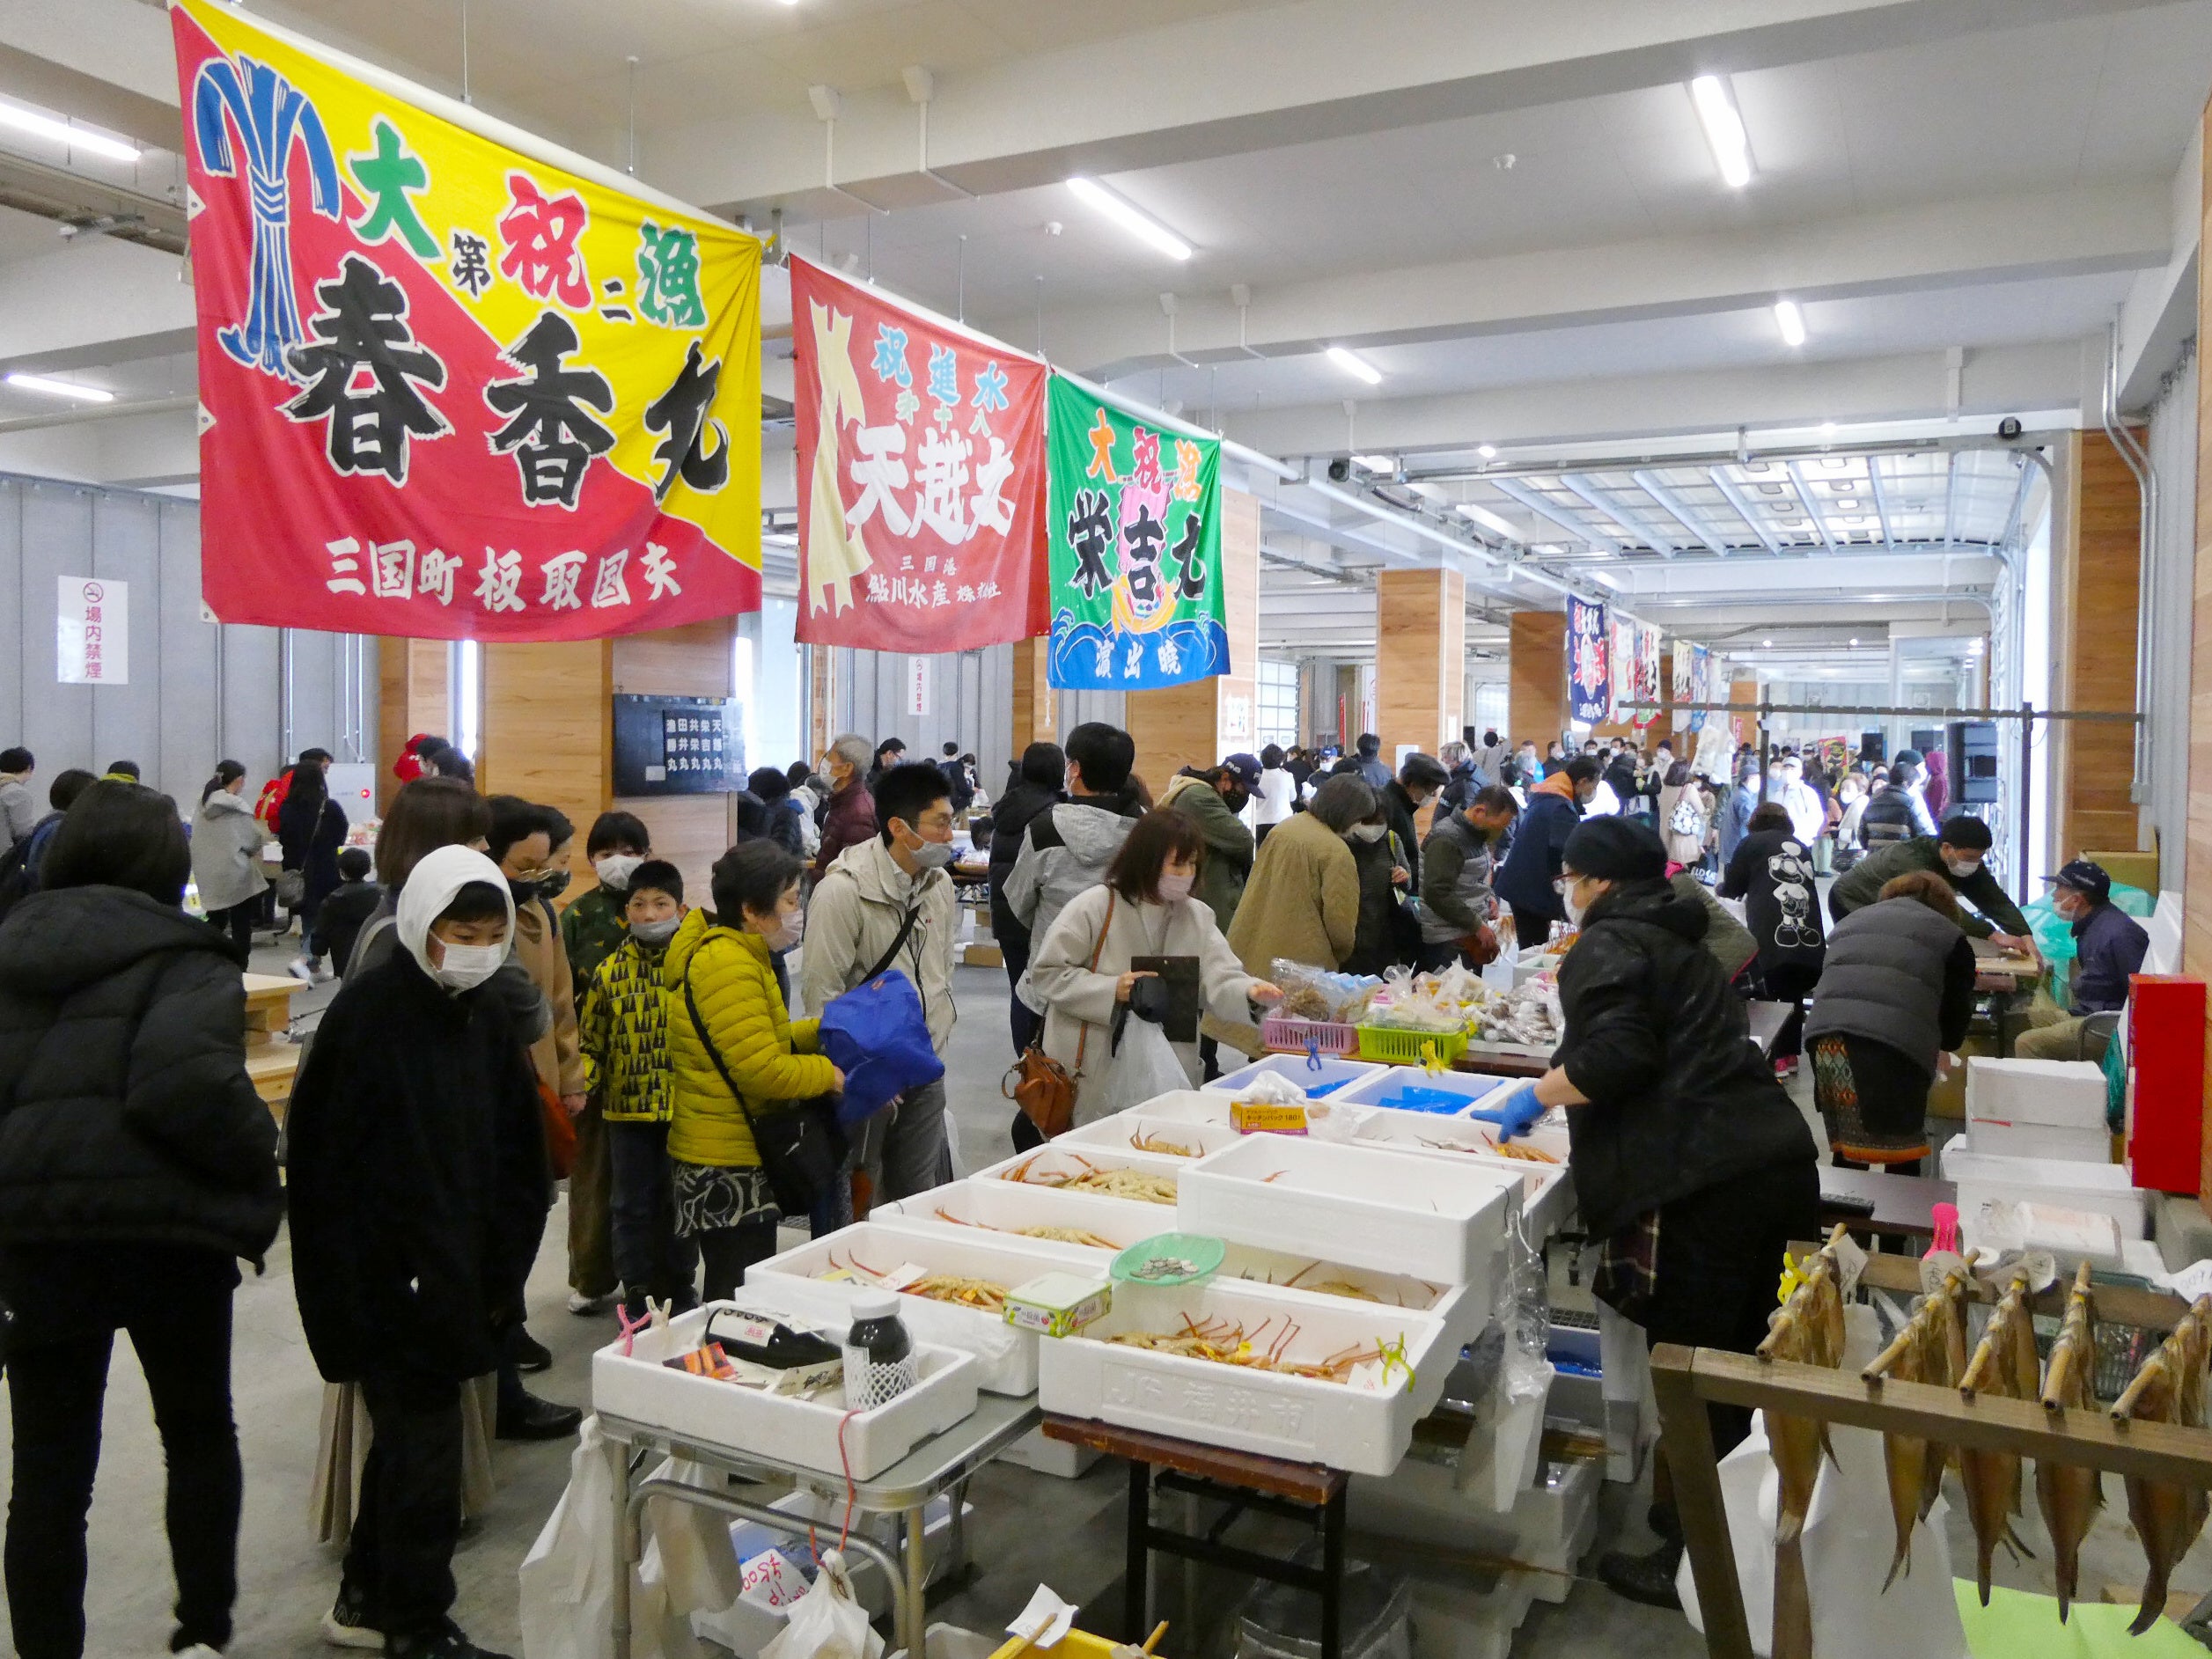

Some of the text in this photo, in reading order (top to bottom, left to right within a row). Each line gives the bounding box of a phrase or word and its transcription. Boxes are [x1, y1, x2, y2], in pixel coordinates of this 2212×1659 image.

[276, 257, 731, 511] 春香丸
[85, 606, 102, 679] 場内禁煙
